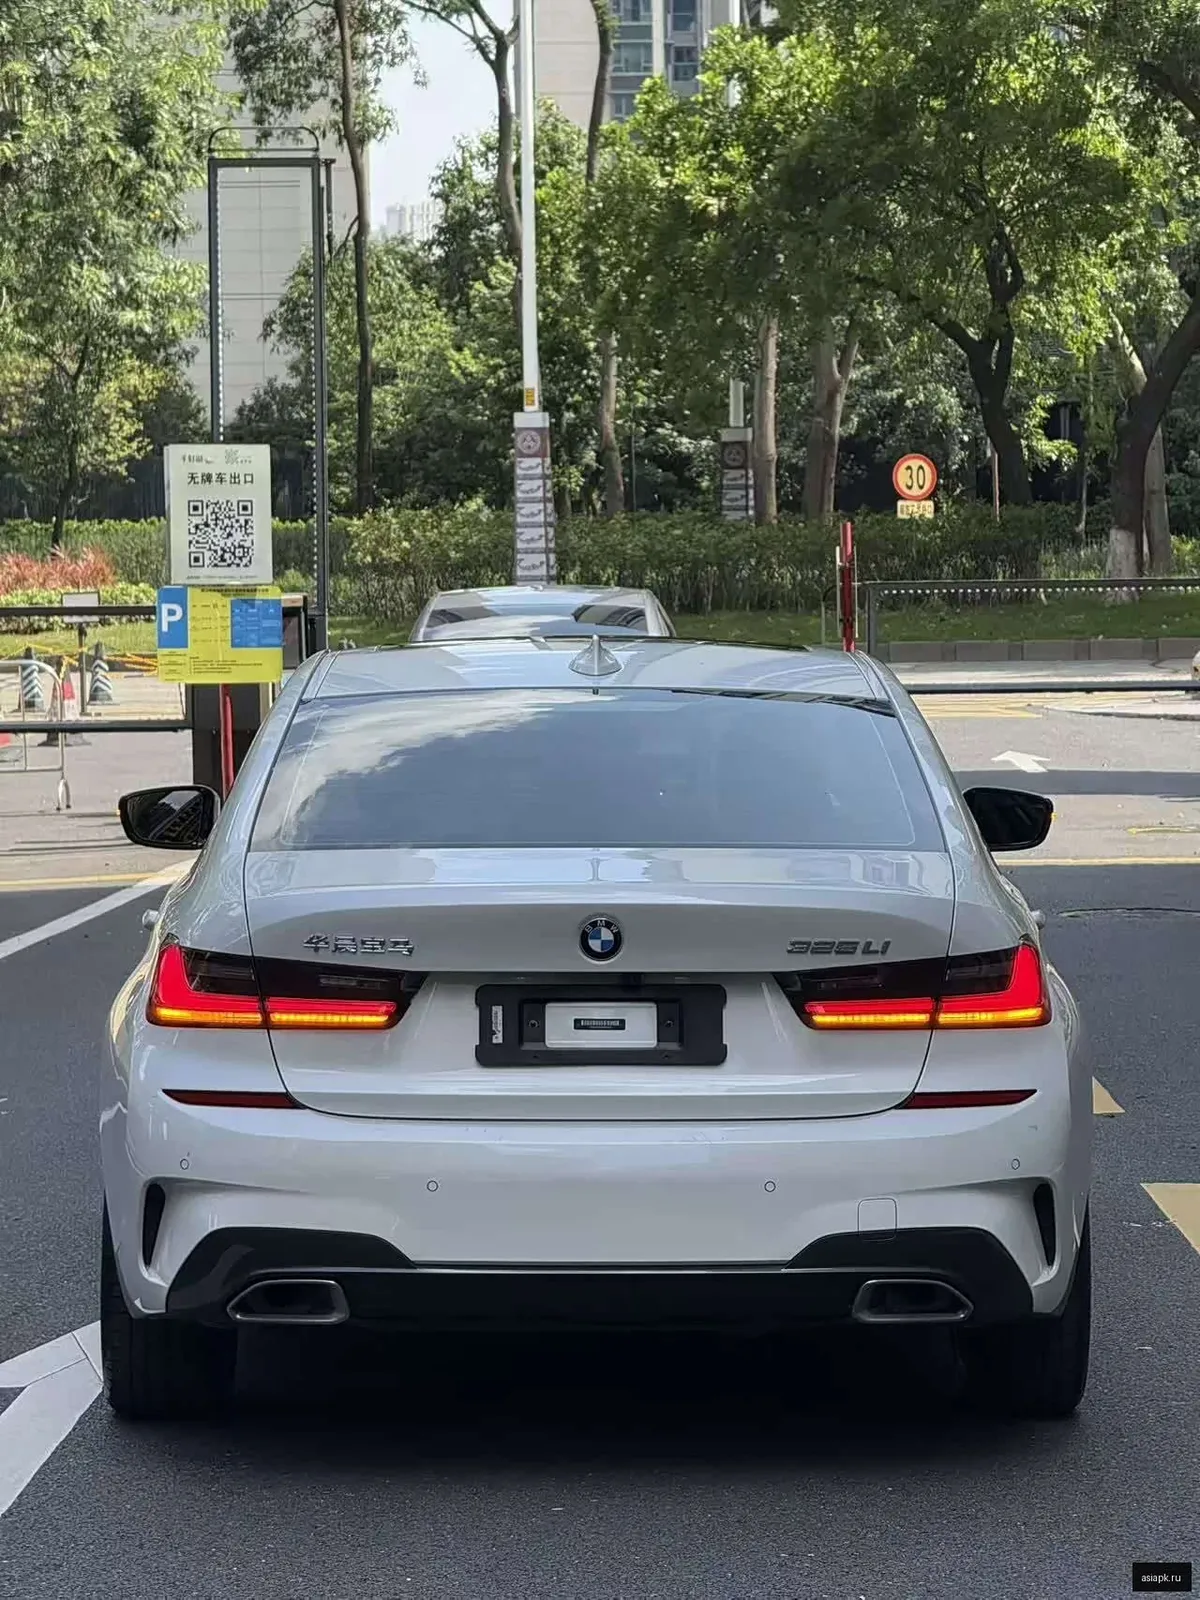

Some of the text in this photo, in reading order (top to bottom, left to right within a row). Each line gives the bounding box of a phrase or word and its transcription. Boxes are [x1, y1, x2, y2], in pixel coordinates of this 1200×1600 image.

[187, 472, 254, 485] 无牌车出口
[905, 465, 925, 490] 30
[161, 603, 183, 632] P
[585, 920, 618, 933] BMW
[303, 934, 414, 956] 华晨宝马
